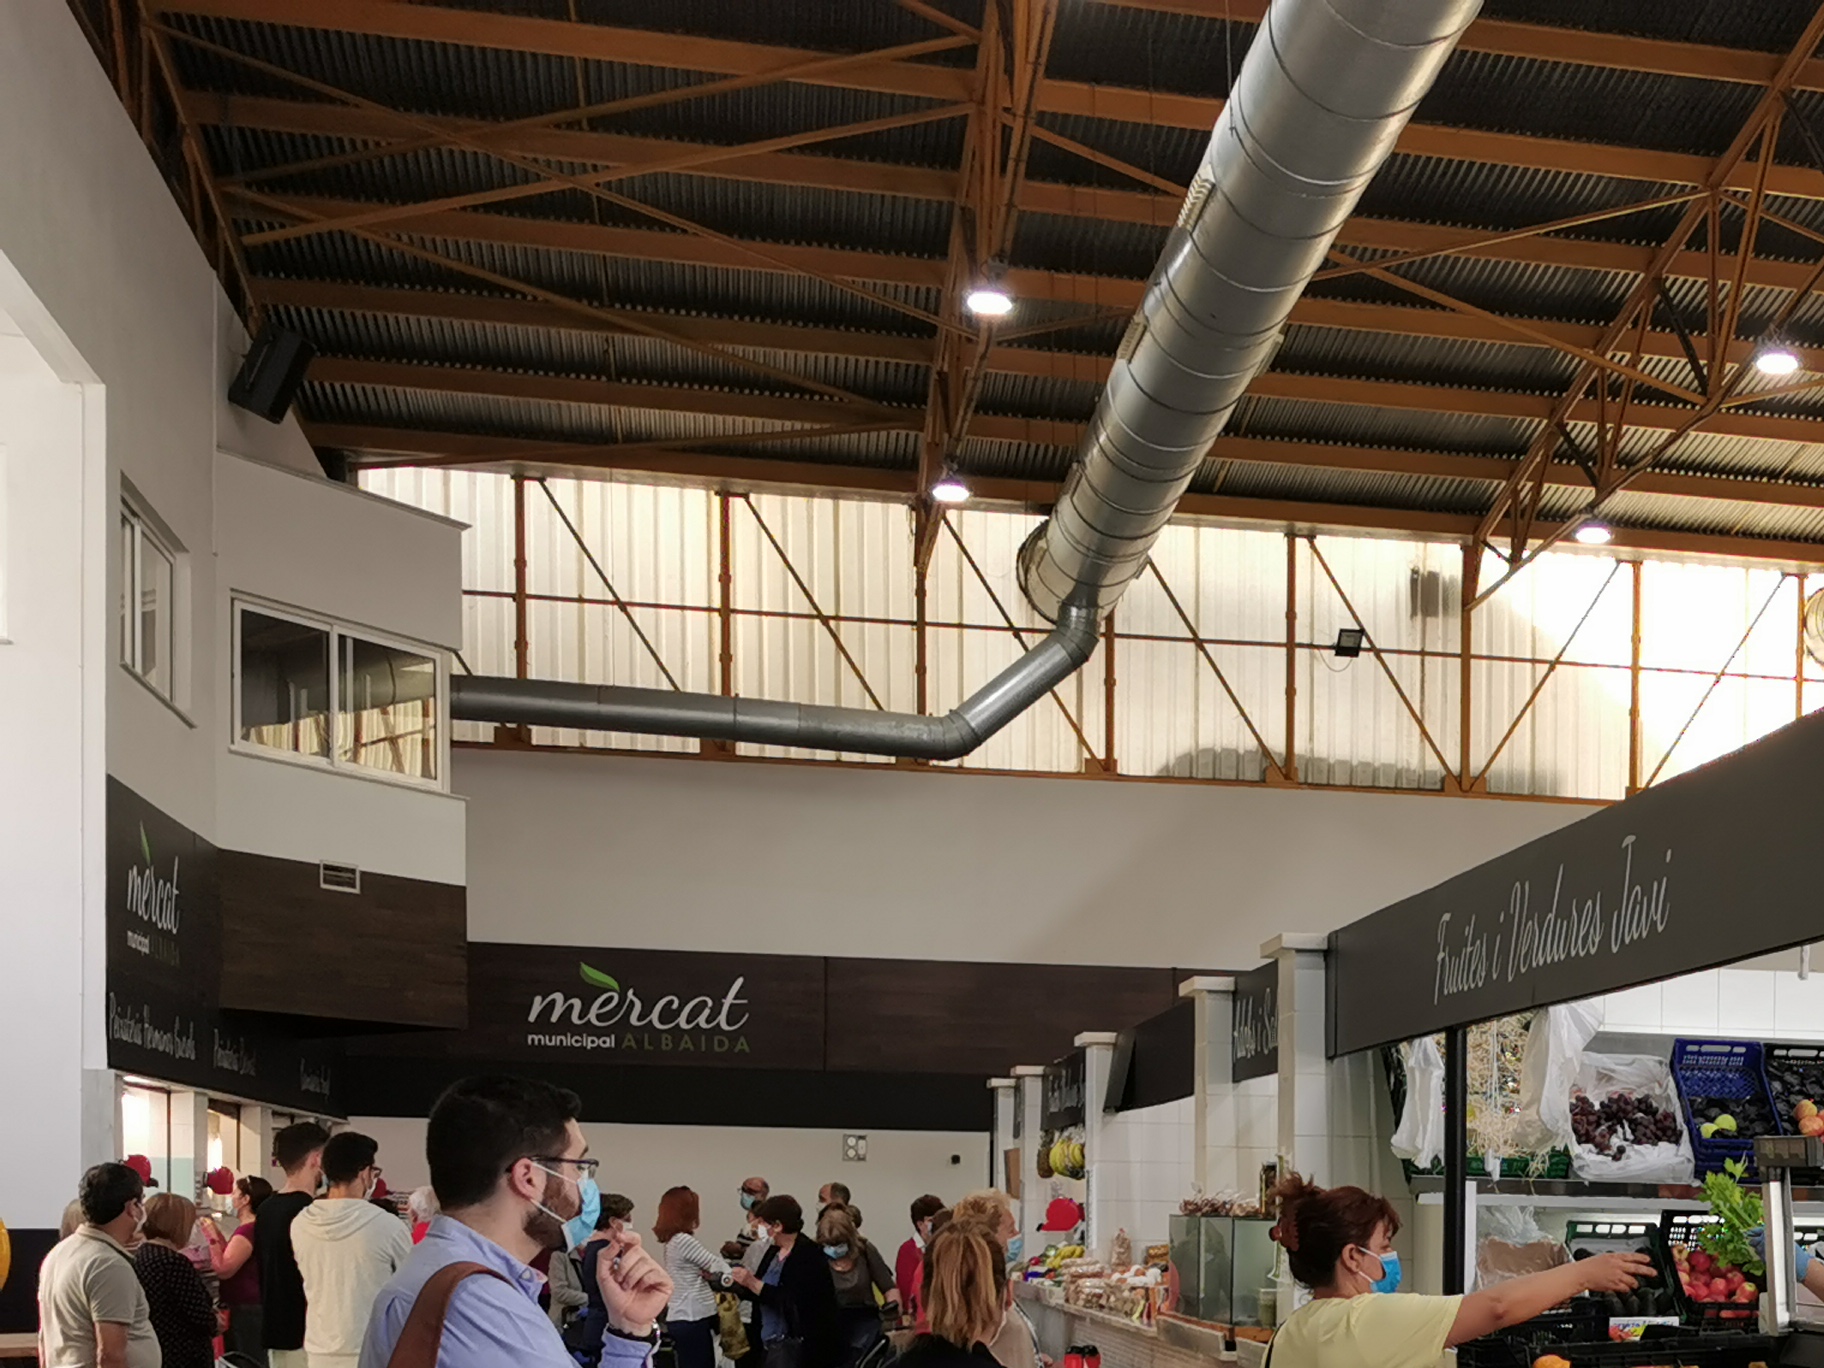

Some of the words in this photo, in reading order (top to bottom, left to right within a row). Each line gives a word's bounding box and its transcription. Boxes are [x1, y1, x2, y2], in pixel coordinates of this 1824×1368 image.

[126, 856, 180, 934] mercat
[1433, 912, 1489, 1005] Fruites
[1492, 911, 1505, 981] i
[1507, 863, 1605, 982] Verdures
[1610, 834, 1673, 953] Javi
[527, 976, 750, 1031] mercat
[527, 1033, 616, 1050] municipal
[621, 1033, 751, 1053] ALBAIDA
